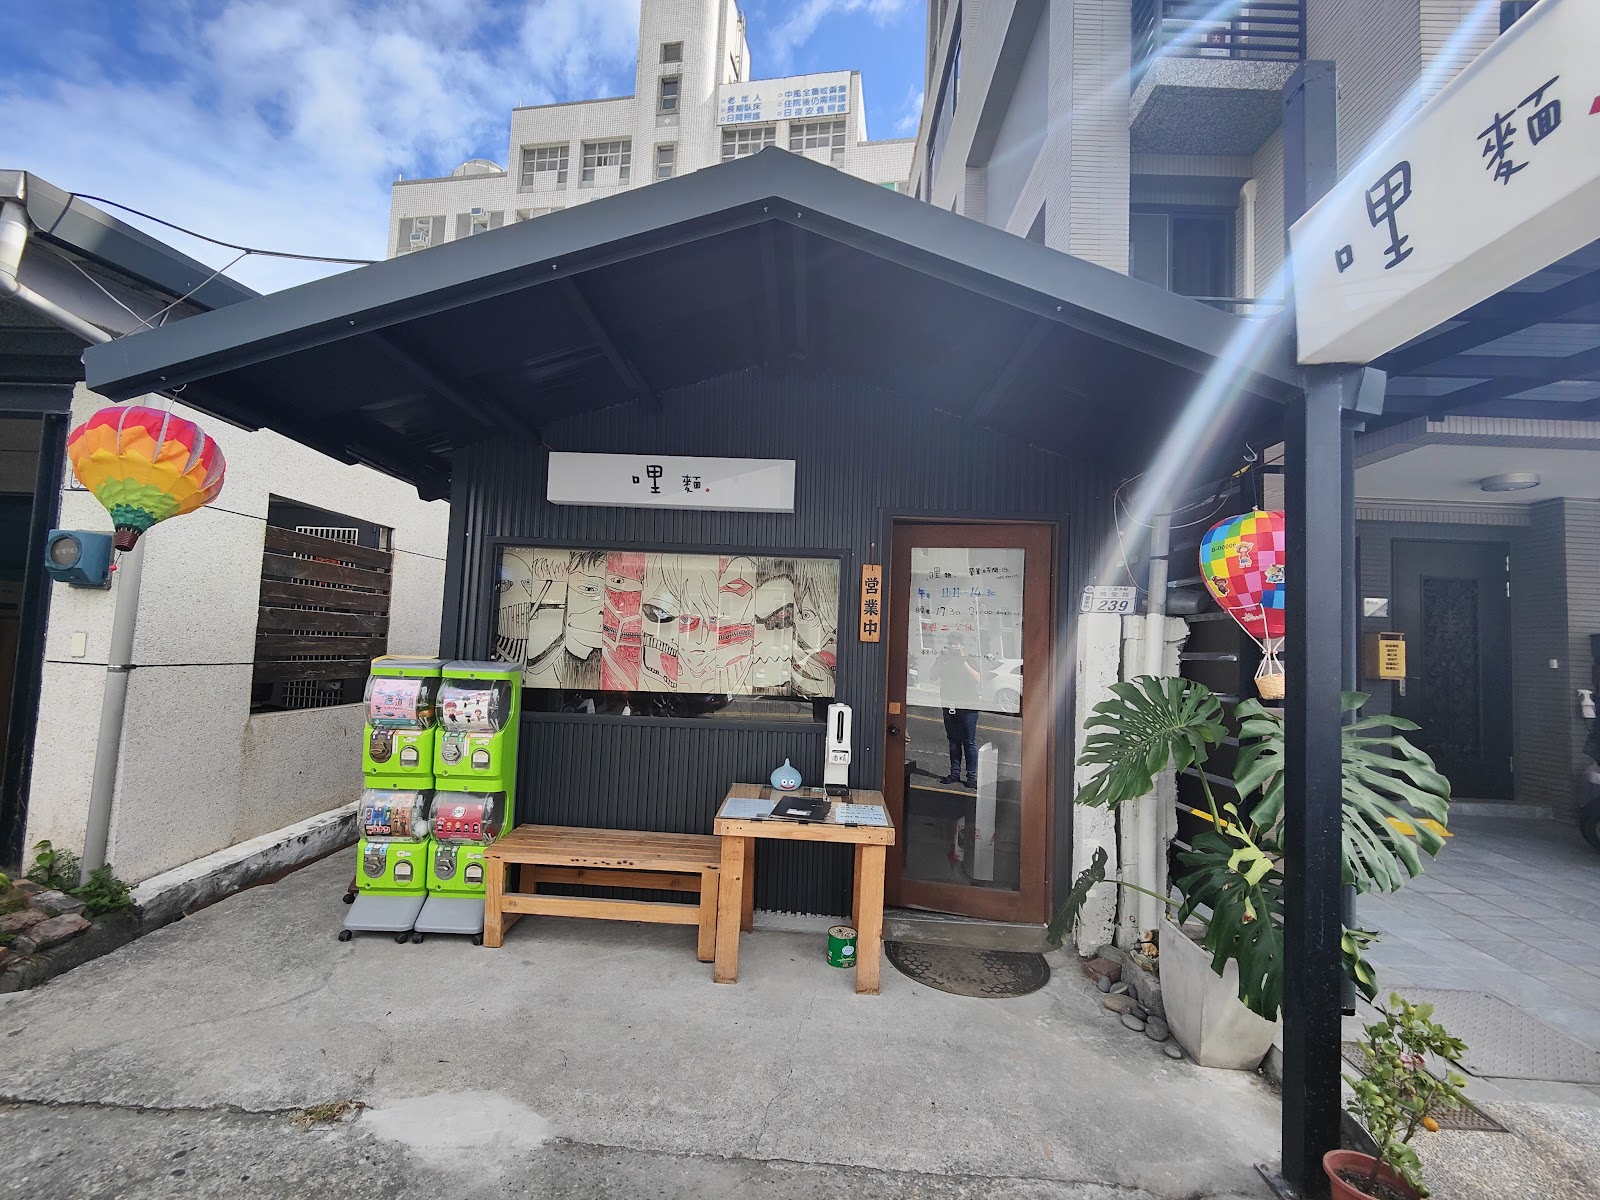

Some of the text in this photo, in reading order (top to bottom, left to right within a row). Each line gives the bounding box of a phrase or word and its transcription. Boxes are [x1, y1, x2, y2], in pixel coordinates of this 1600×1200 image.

[727, 94, 762, 104] 老年人
[784, 94, 846, 108] 住院後仍需照護
[727, 103, 762, 113] 長期臥床
[784, 104, 846, 117] 日夜安養照護
[727, 112, 761, 122] 日間照護
[864, 576, 880, 637] 営業中
[1097, 600, 1129, 612] 239
